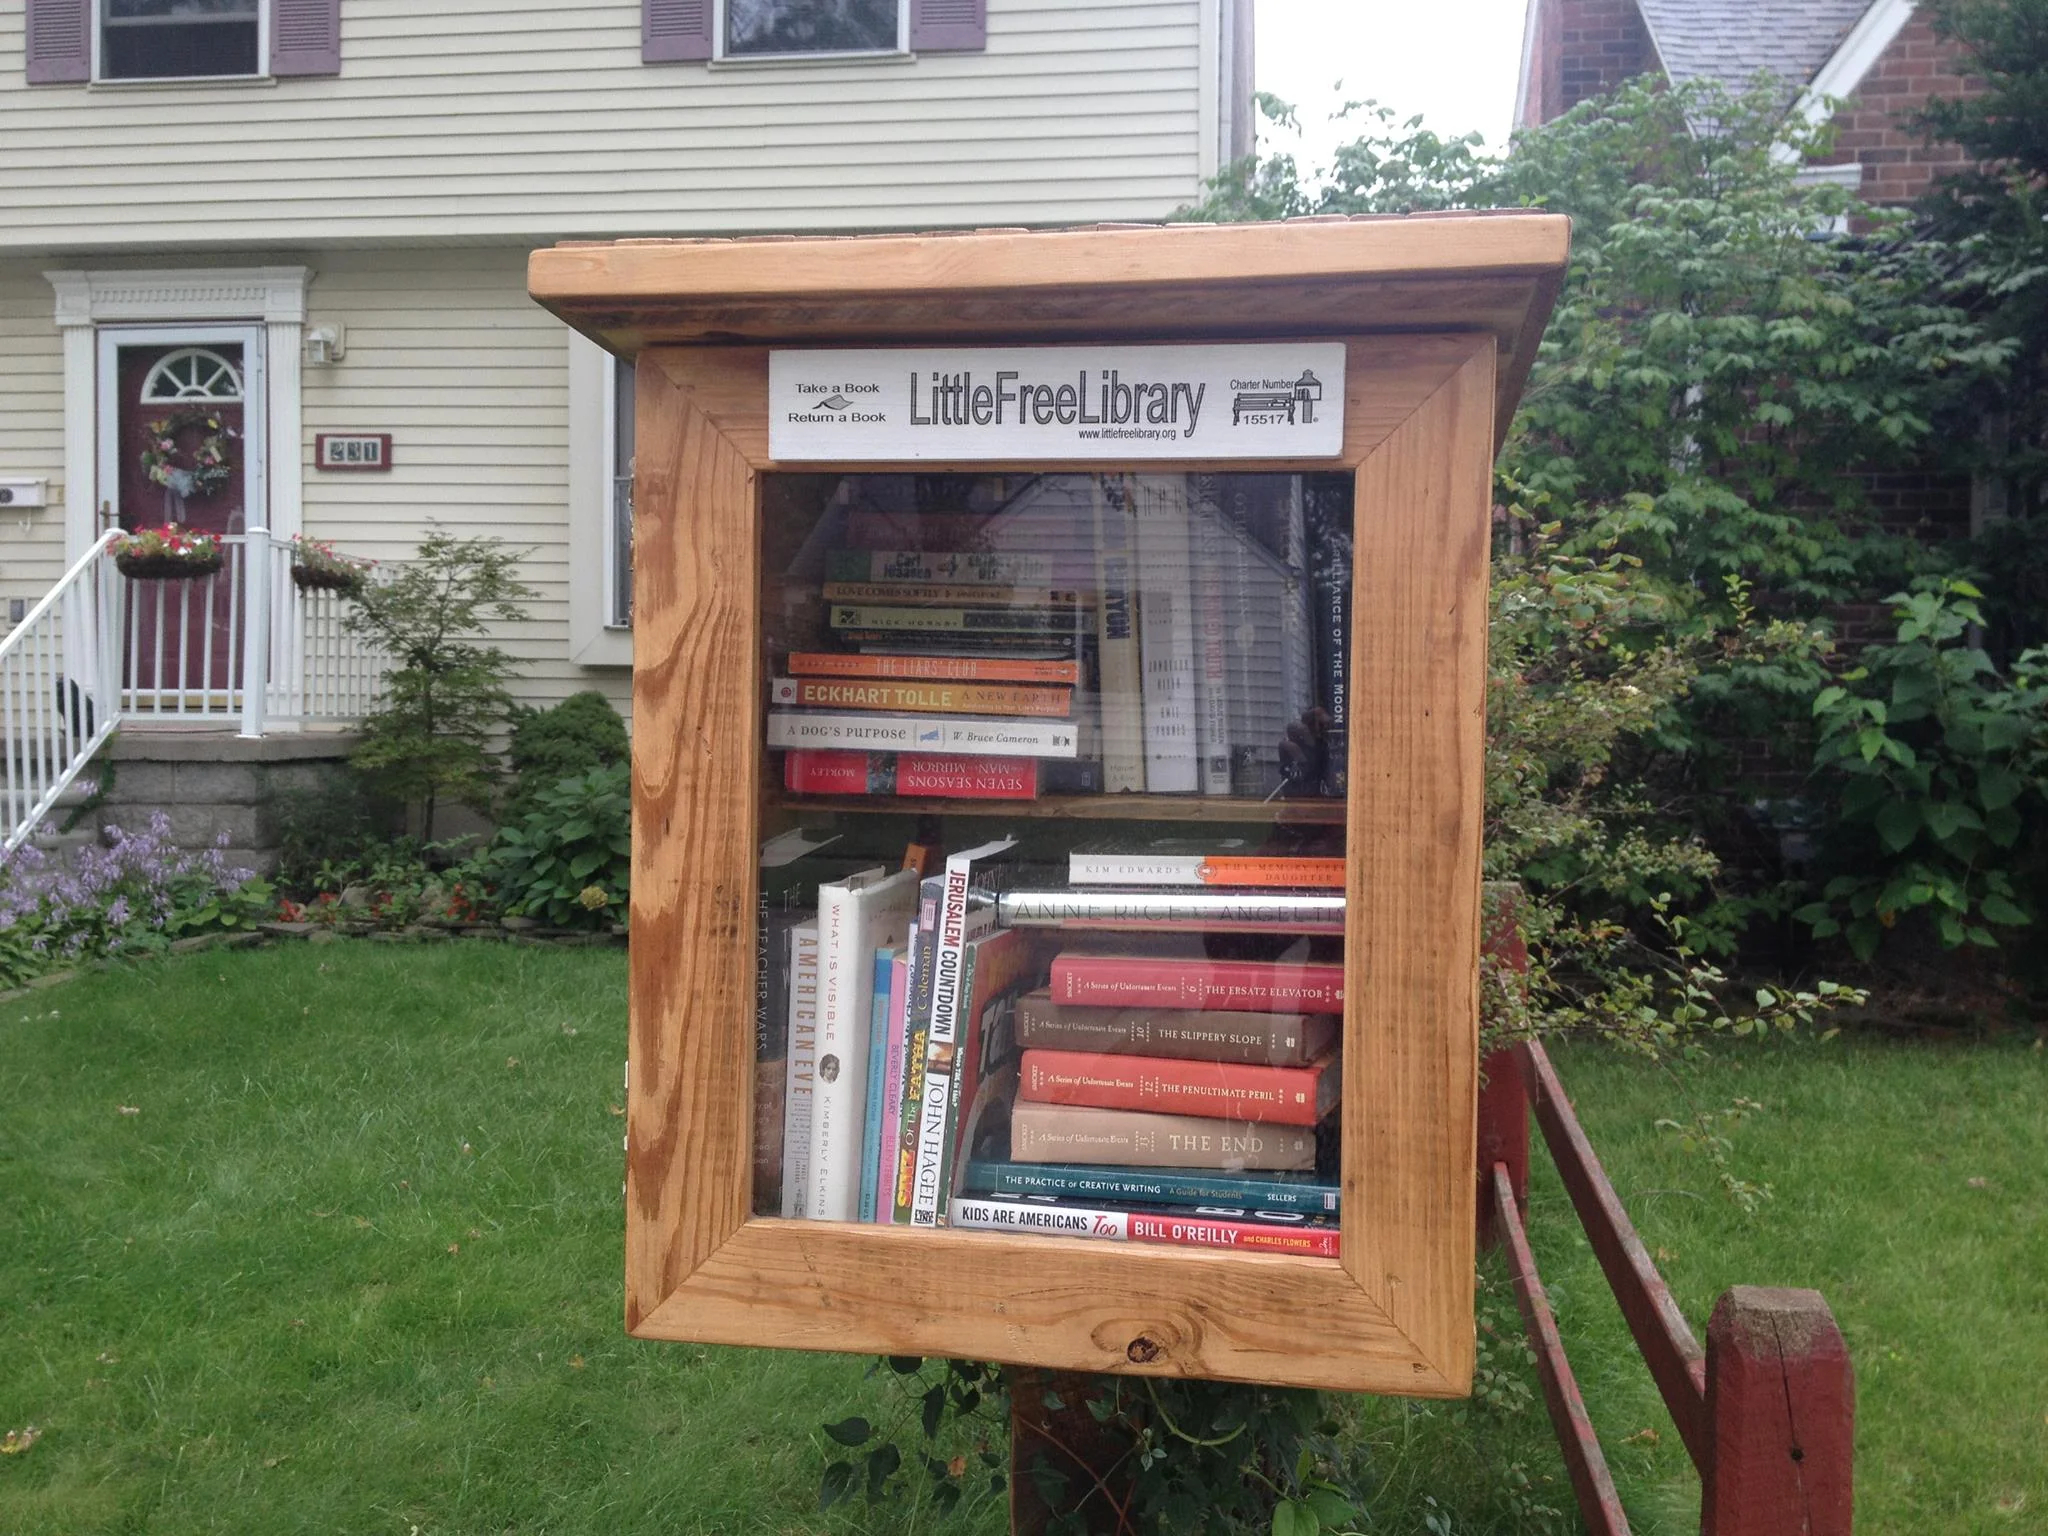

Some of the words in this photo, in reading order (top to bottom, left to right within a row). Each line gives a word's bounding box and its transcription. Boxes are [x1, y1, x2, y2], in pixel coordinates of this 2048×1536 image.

[795, 383, 828, 393] Take
[832, 385, 841, 393] a
[845, 383, 880, 393] Book
[1230, 379, 1260, 390] Charter
[1262, 379, 1294, 390] Number
[910, 370, 1206, 437] LittleFreeLibrary
[788, 413, 834, 422] Return
[838, 414, 847, 422] a
[851, 413, 886, 422] Book
[1243, 414, 1285, 425] 15517
[1078, 428, 1176, 440] www.littlefreelibrary.org
[1332, 628, 1342, 646] OF
[875, 657, 897, 674] THE
[903, 658, 944, 676] LIARS'
[948, 660, 977, 677] CLUB
[1205, 639, 1223, 680] TRUTH
[1332, 651, 1343, 678] THE
[803, 685, 890, 705] ECKHART
[895, 690, 952, 707] TOLLE
[961, 690, 972, 699] A
[976, 690, 1008, 701] NEW
[1333, 684, 1344, 724] MOON
[787, 725, 796, 736] A
[801, 725, 841, 737] DOG'S
[952, 731, 964, 741] W.
[967, 731, 994, 743] Bruce
[996, 733, 1039, 744] Cameron
[912, 761, 966, 774] MIRROR
[977, 763, 1009, 775] MAN
[907, 776, 972, 789] SEASONS
[976, 778, 1023, 790] SEVEN
[1086, 865, 1110, 874] KIM
[1119, 866, 1182, 874] EDWARDS
[1265, 873, 1333, 882] DAUGHTER
[759, 890, 768, 919] THE
[944, 869, 967, 948] JERUSALEM
[1015, 901, 1102, 921] ANNE
[1114, 904, 1183, 922] RICE
[1220, 904, 1307, 923] ANGEL
[831, 904, 841, 946] WHAT
[829, 956, 838, 970] IS
[916, 945, 932, 1010] Coleman
[796, 937, 818, 1051] AMERICAN
[935, 951, 959, 1036] COUNTDOWN
[1091, 983, 1108, 991] Series
[1111, 983, 1119, 991] of
[1205, 985, 1226, 995] THE
[1229, 986, 1266, 997] ERSATZ
[1270, 987, 1322, 999] ELEVATOR
[826, 977, 837, 1041] VISIBLE
[757, 1005, 767, 1051] WARS
[1158, 1028, 1178, 1039] THE
[1181, 1029, 1227, 1042] SLIPPERY
[1230, 1032, 1263, 1045] SLOPE
[890, 1044, 898, 1079] BEVERLY
[794, 1059, 813, 1095] EVE
[1047, 1074, 1055, 1082] A
[1055, 1075, 1072, 1084] Series
[1073, 1076, 1082, 1085] of
[888, 1082, 896, 1114] CLEARY
[1162, 1083, 1180, 1093] THE
[1183, 1084, 1246, 1098] PENULTIMATE
[1249, 1089, 1274, 1100] PERIL
[926, 1081, 945, 1130] JOHN
[820, 1096, 832, 1162] KIMBERLY
[904, 1126, 915, 1146] Of
[1066, 1134, 1074, 1143] of
[1169, 1135, 1211, 1151] THE
[1221, 1136, 1263, 1153] END
[918, 1132, 940, 1205] HAGEE
[817, 1168, 828, 1216] ELKINS
[1005, 1176, 1023, 1185] THE
[1025, 1177, 1065, 1188] PRACTICE
[1079, 1180, 1120, 1191] CREATIVE
[1122, 1183, 1161, 1194] WRITING
[1176, 1188, 1197, 1197] Guide
[1199, 1189, 1209, 1197] for
[1211, 1190, 1242, 1200] Students
[1267, 1193, 1297, 1202] SELLERS
[962, 1206, 989, 1222] KIDS
[992, 1210, 1015, 1224] ARE
[1018, 1211, 1087, 1231] AMERICANS
[1091, 1214, 1118, 1237] Too
[1135, 1221, 1167, 1238] BILL
[1172, 1224, 1238, 1245] O'REILLY
[1243, 1235, 1255, 1243] and
[1255, 1236, 1281, 1245] CHARLES
[1283, 1238, 1311, 1249] FLOWERS
